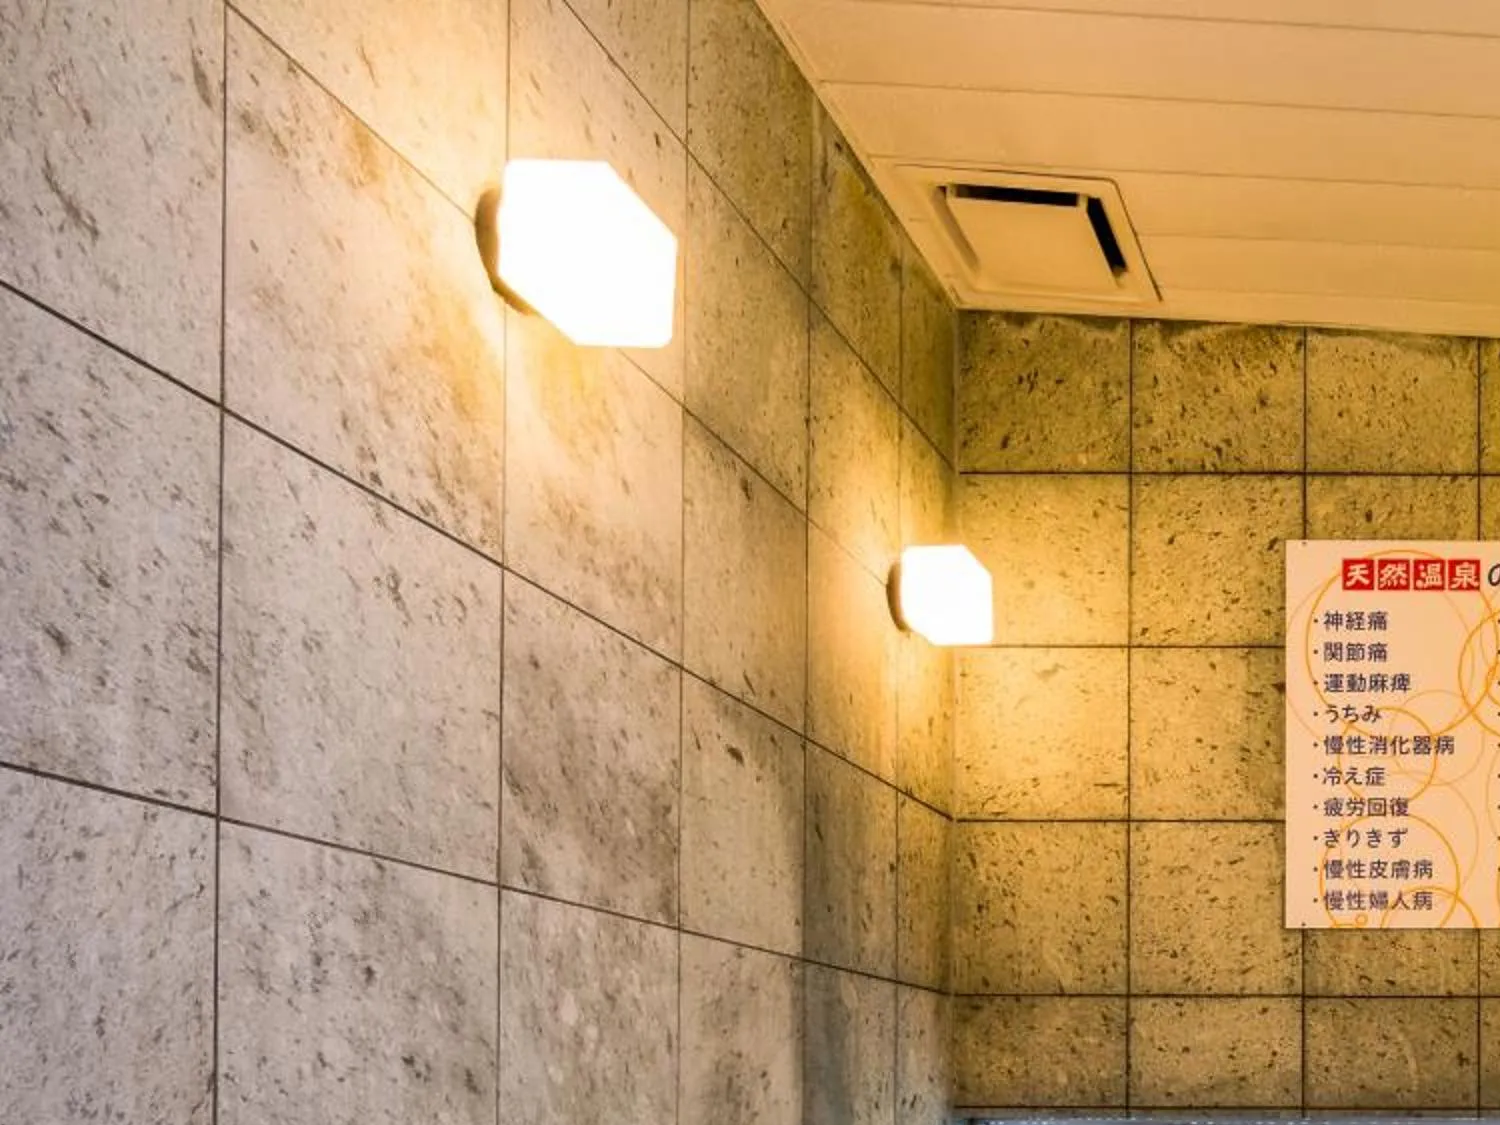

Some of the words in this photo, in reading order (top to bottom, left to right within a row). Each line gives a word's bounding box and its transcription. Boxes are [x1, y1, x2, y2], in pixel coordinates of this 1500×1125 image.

[1323, 610, 1387, 631] 神経痛
[1323, 641, 1388, 663] 関節痛
[1324, 673, 1411, 693] 運動麻痺
[1325, 704, 1382, 724] うちみ
[1323, 735, 1455, 756] 慢性消化器病
[1322, 766, 1385, 786] 冷え症
[1323, 797, 1410, 817] 疲労回復
[1323, 828, 1408, 849] きりきず
[1323, 859, 1433, 880] 慢性皮膚病
[1323, 890, 1433, 911] 慢性婦人病
